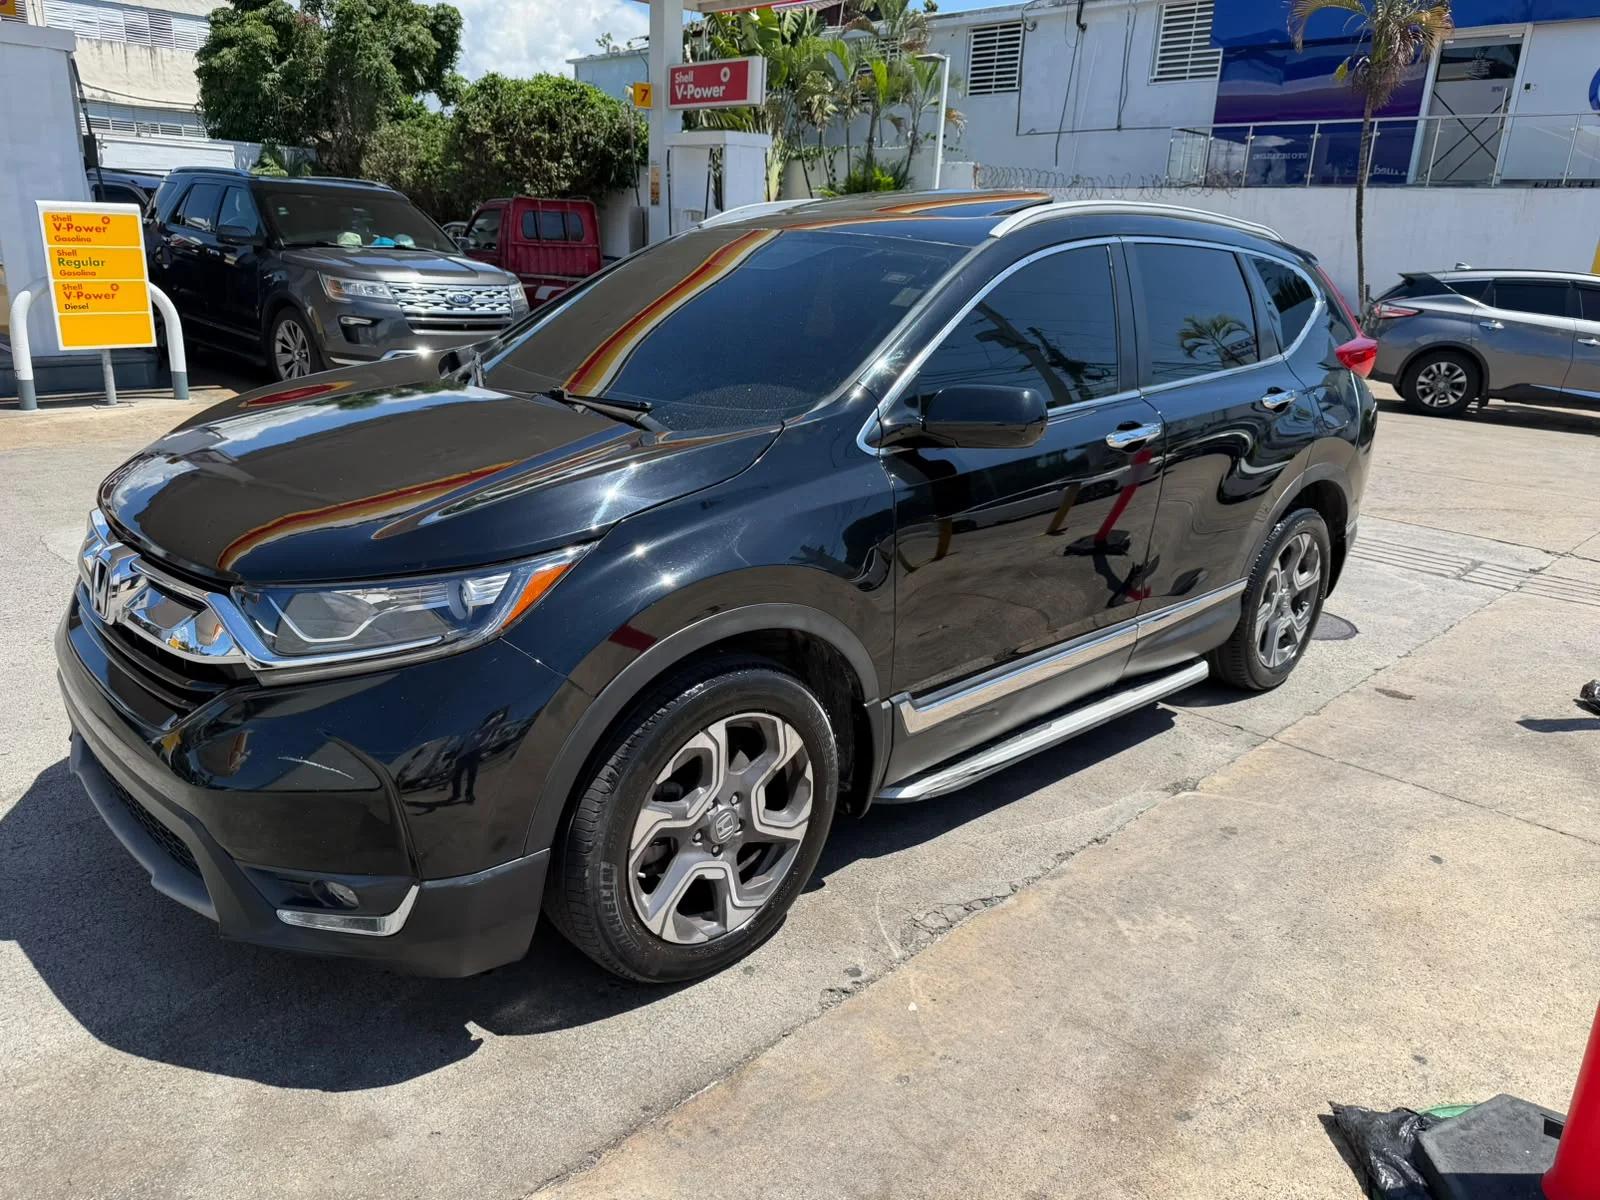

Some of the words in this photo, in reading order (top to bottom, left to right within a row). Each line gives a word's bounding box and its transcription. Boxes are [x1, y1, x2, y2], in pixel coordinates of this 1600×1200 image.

[675, 70, 694, 83] Shell
[641, 88, 649, 102] 7
[675, 84, 725, 99] V-Power
[51, 214, 72, 222] Shell
[53, 222, 107, 233] V-Power
[57, 257, 105, 268] Regular
[63, 291, 116, 300] V-Power
